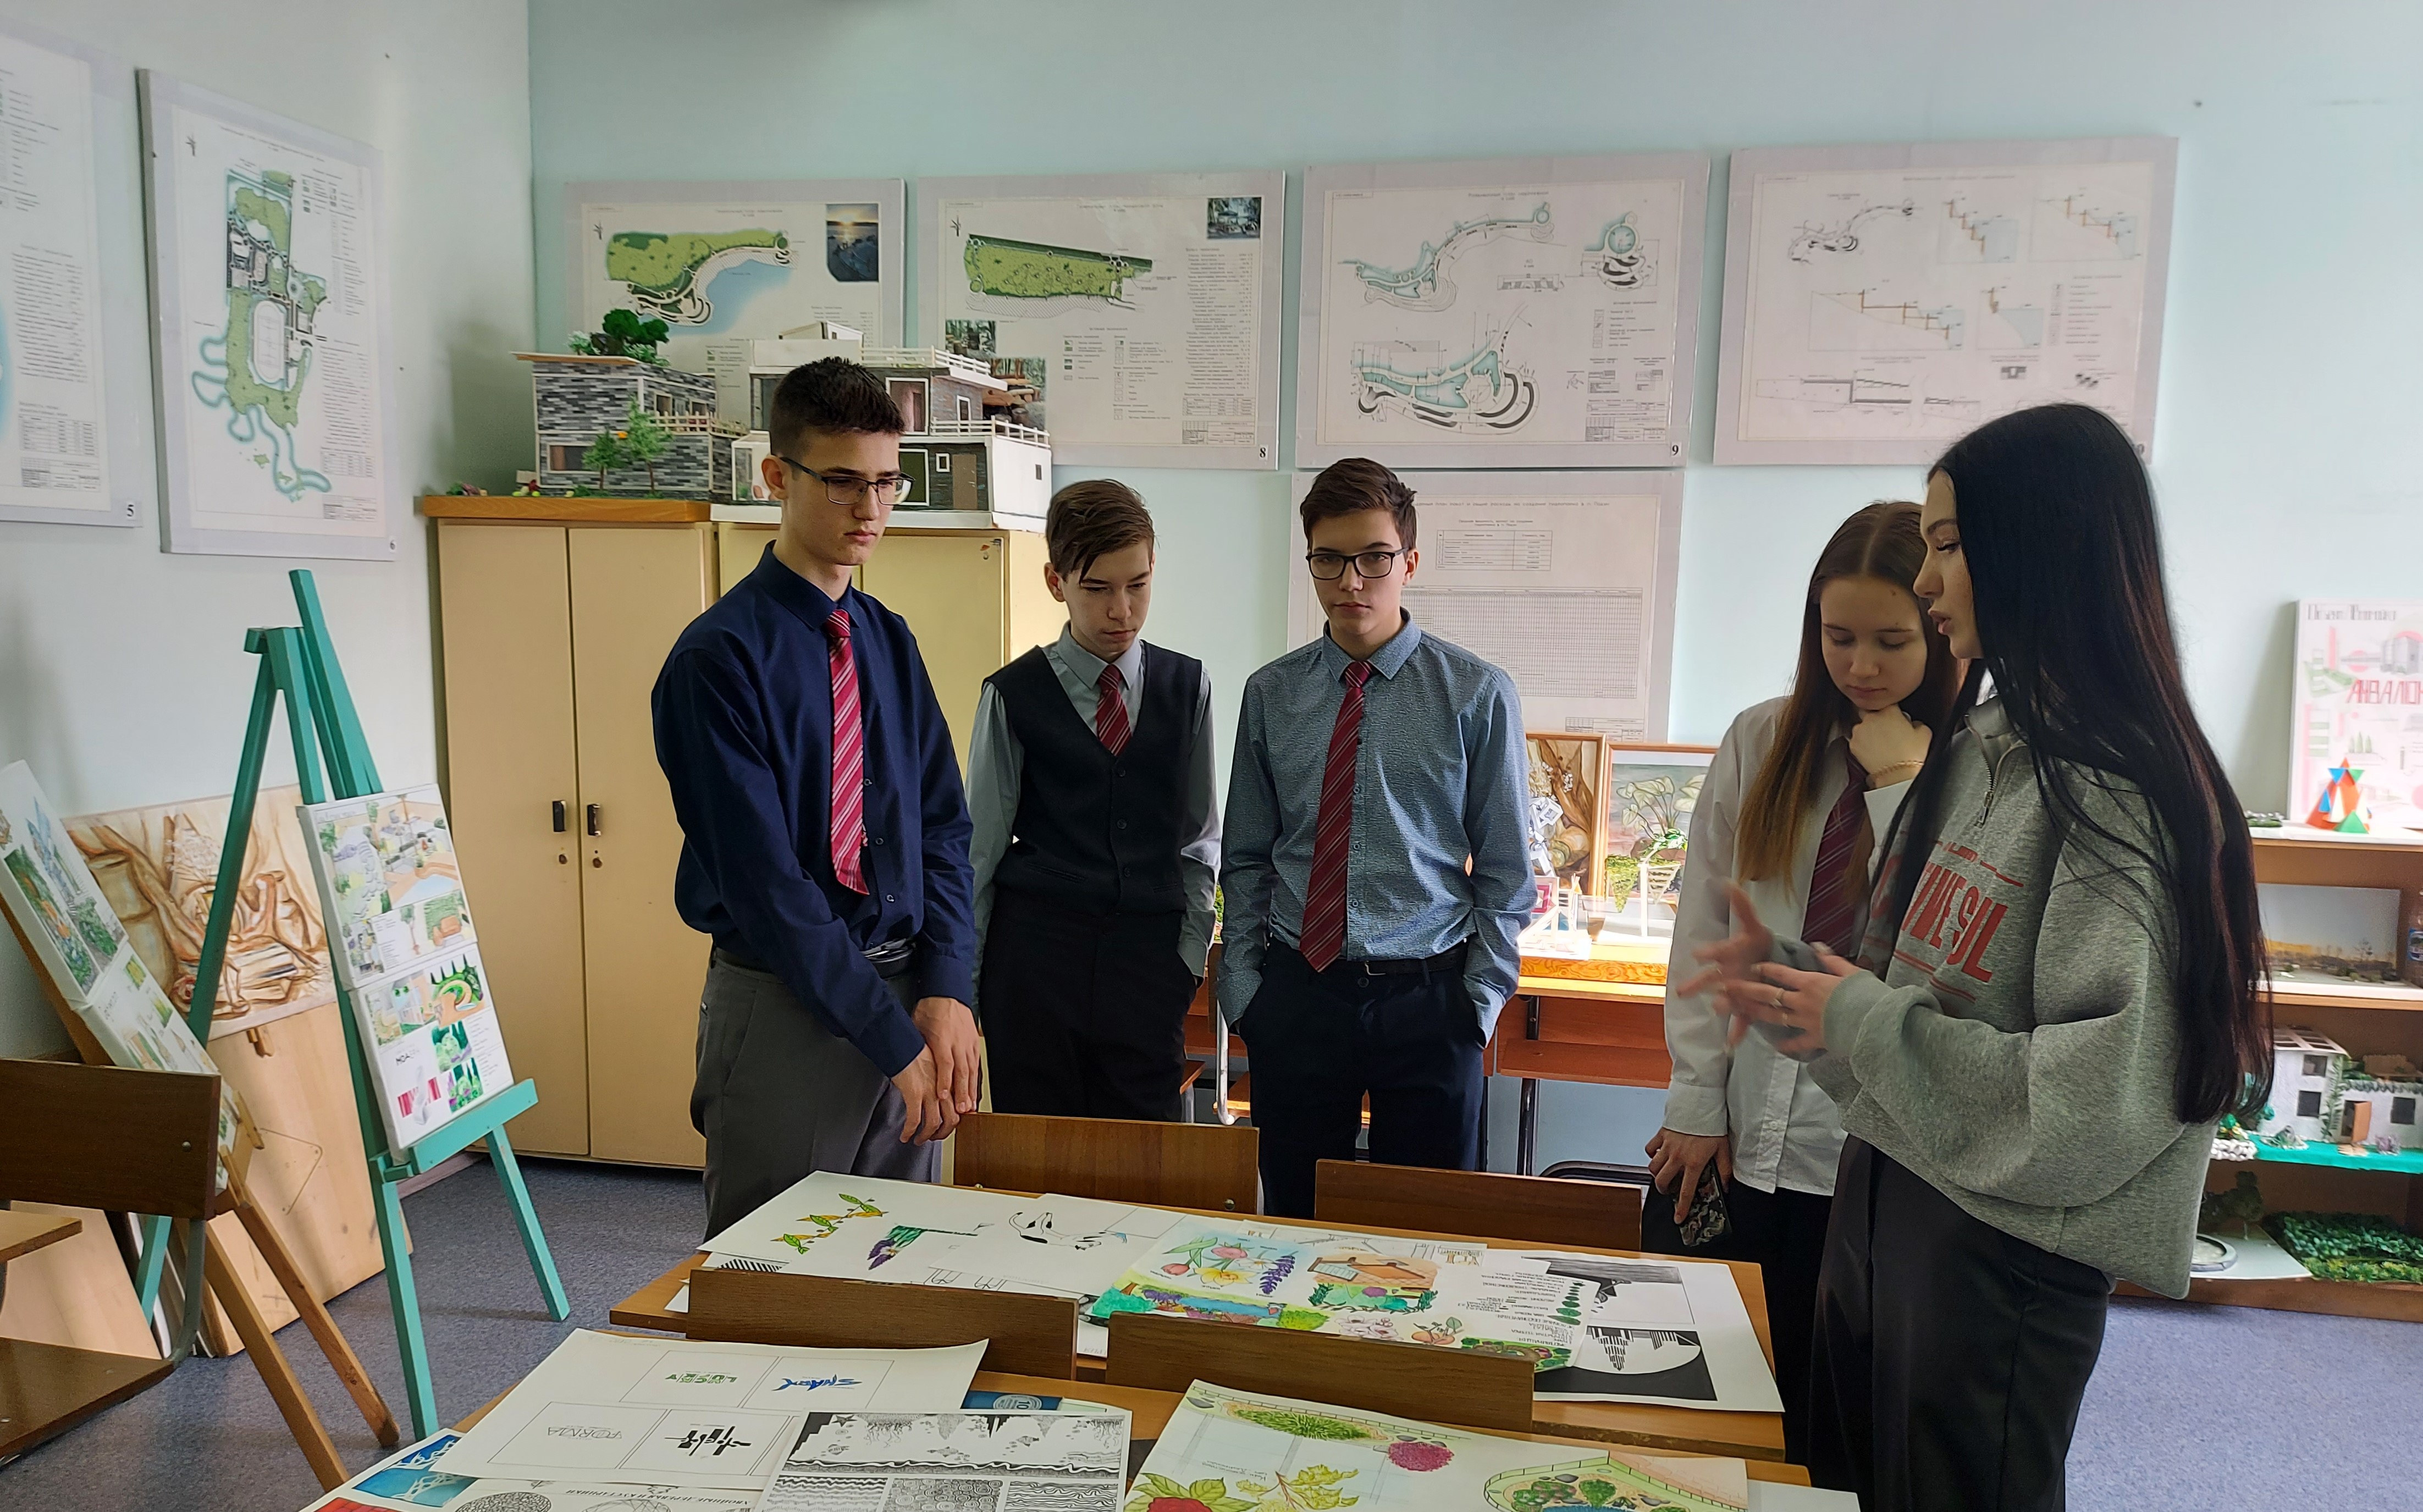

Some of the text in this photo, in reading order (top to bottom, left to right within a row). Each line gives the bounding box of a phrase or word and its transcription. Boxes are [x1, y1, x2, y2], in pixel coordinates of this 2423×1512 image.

[1260, 447, 1266, 457] 8
[1672, 445, 1679, 455] 9
[126, 504, 134, 517] 5
[390, 539, 396, 550] 6
[665, 1373, 737, 1384] LUCKY
[548, 1427, 622, 1439] FORMA
